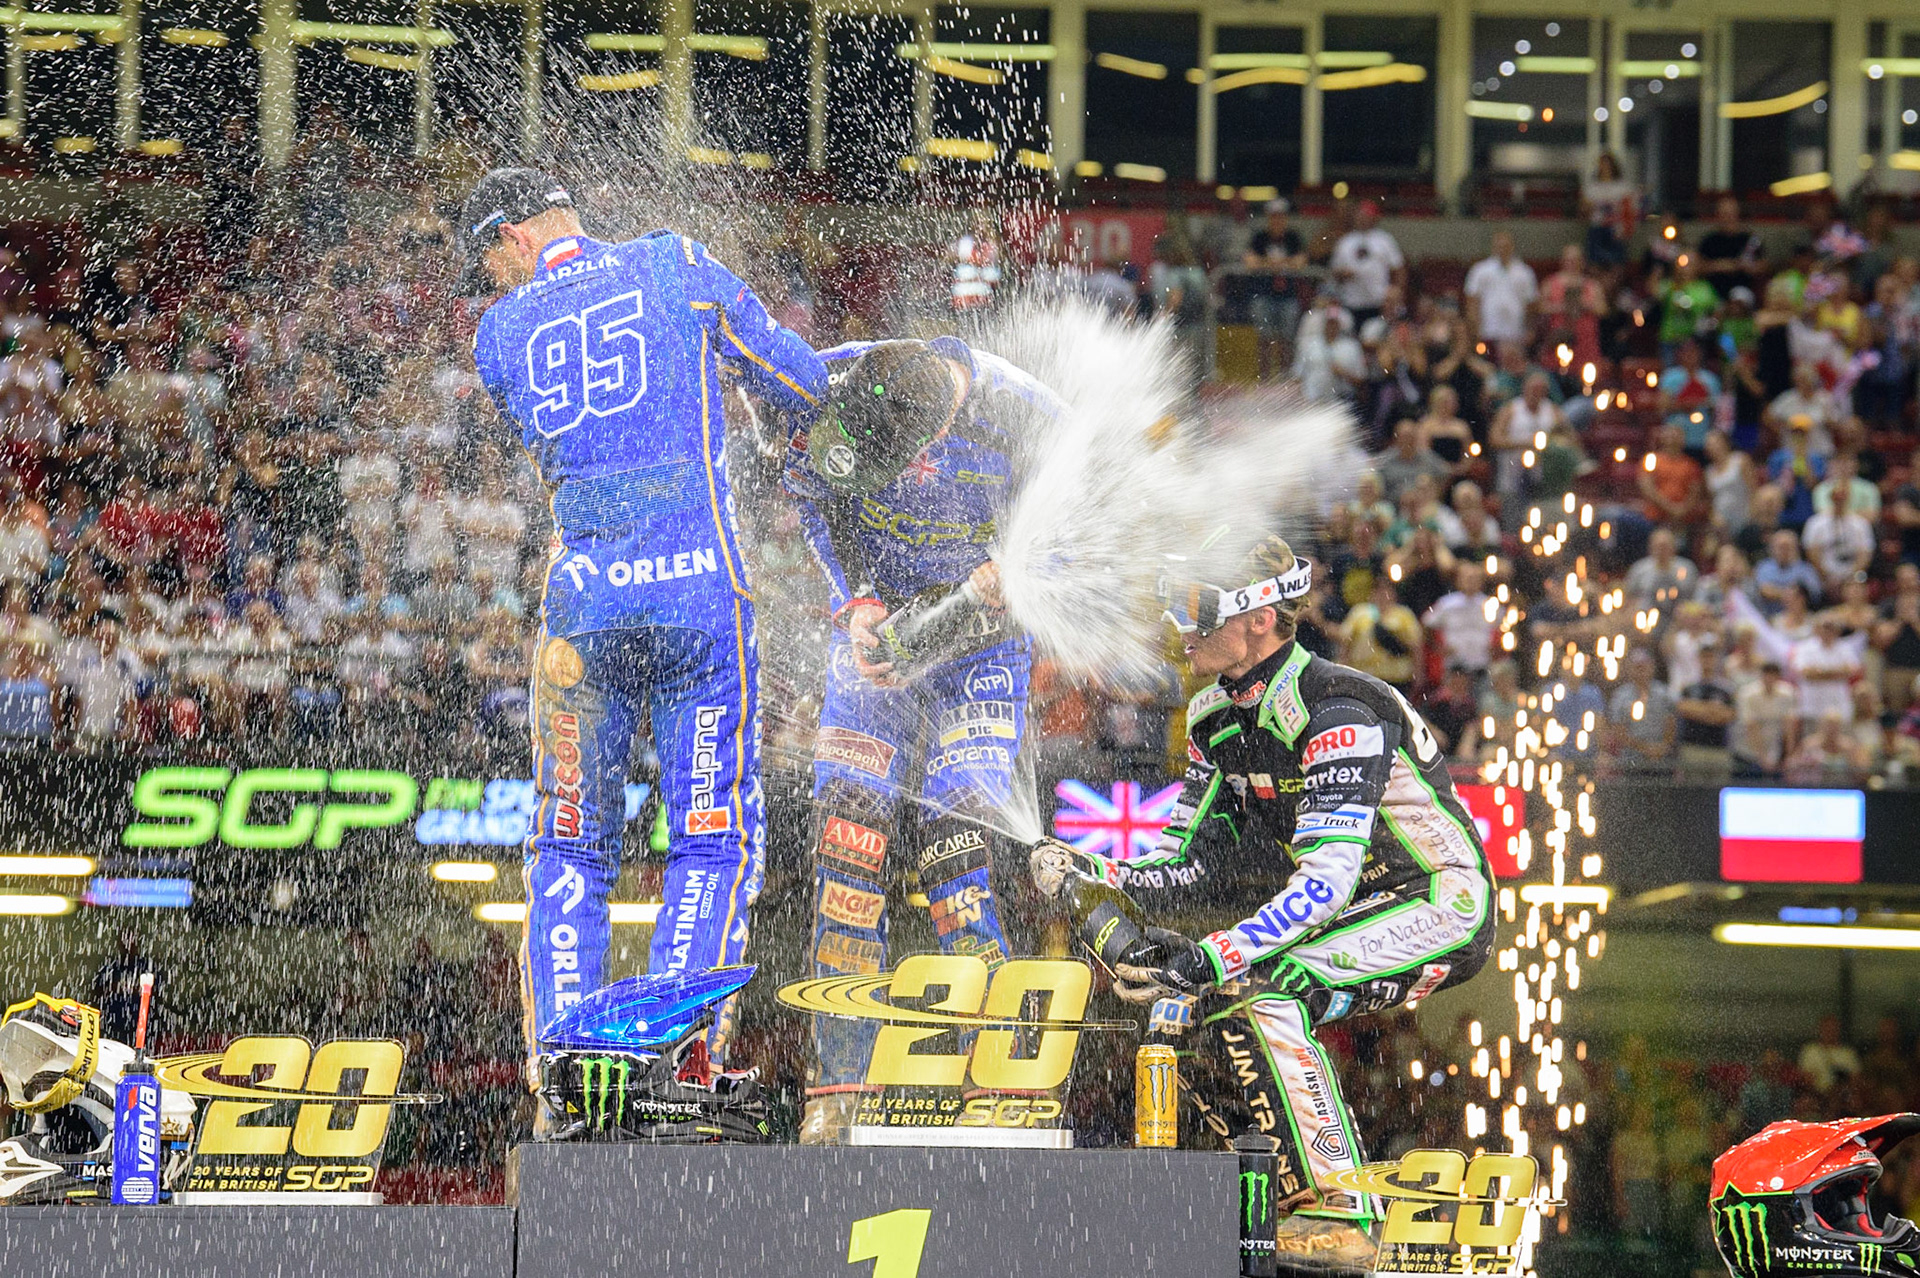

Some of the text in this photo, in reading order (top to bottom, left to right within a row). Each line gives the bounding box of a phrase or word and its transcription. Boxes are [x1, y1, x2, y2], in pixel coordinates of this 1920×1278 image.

[526, 289, 648, 440] 95
[607, 547, 718, 587] ORLEN
[973, 674, 1007, 692] ATPI
[968, 726, 992, 738] plc
[926, 746, 1011, 776] colorama
[121, 767, 417, 849] SGP
[1315, 793, 1343, 803] Toyota
[1323, 816, 1360, 830] Truck
[825, 823, 885, 855] AMD
[706, 872, 720, 891] OIL
[1362, 862, 1391, 884] PRIX
[701, 893, 712, 918] ORLEN
[827, 886, 880, 916] NGK
[1238, 877, 1335, 949] Nice
[1359, 935, 1386, 961] for
[550, 923, 581, 1018] ORLE
[866, 954, 1092, 1090] 20
[1150, 1002, 1193, 1026] POL
[197, 1037, 404, 1157] 20
[632, 1100, 702, 1114] MONSTER
[861, 1098, 960, 1112] 20 YEARS OF
[643, 1113, 693, 1121] ENERGY
[857, 1113, 955, 1126] FIM BRITISH
[961, 1098, 1063, 1128] SGP
[193, 1166, 284, 1177] 20 YEARS OF
[283, 1166, 374, 1192] SGP
[189, 1180, 279, 1191] FIM BRITISH
[1382, 1149, 1538, 1247] 20
[847, 1208, 932, 1278] 1
[1775, 1247, 1855, 1262] MONSTER
[1377, 1262, 1445, 1273] FIM BRITISH
[1380, 1252, 1449, 1262] 20 YEARS OF
[1448, 1252, 1516, 1275] SGP
[1787, 1262, 1844, 1270] ENERGY
